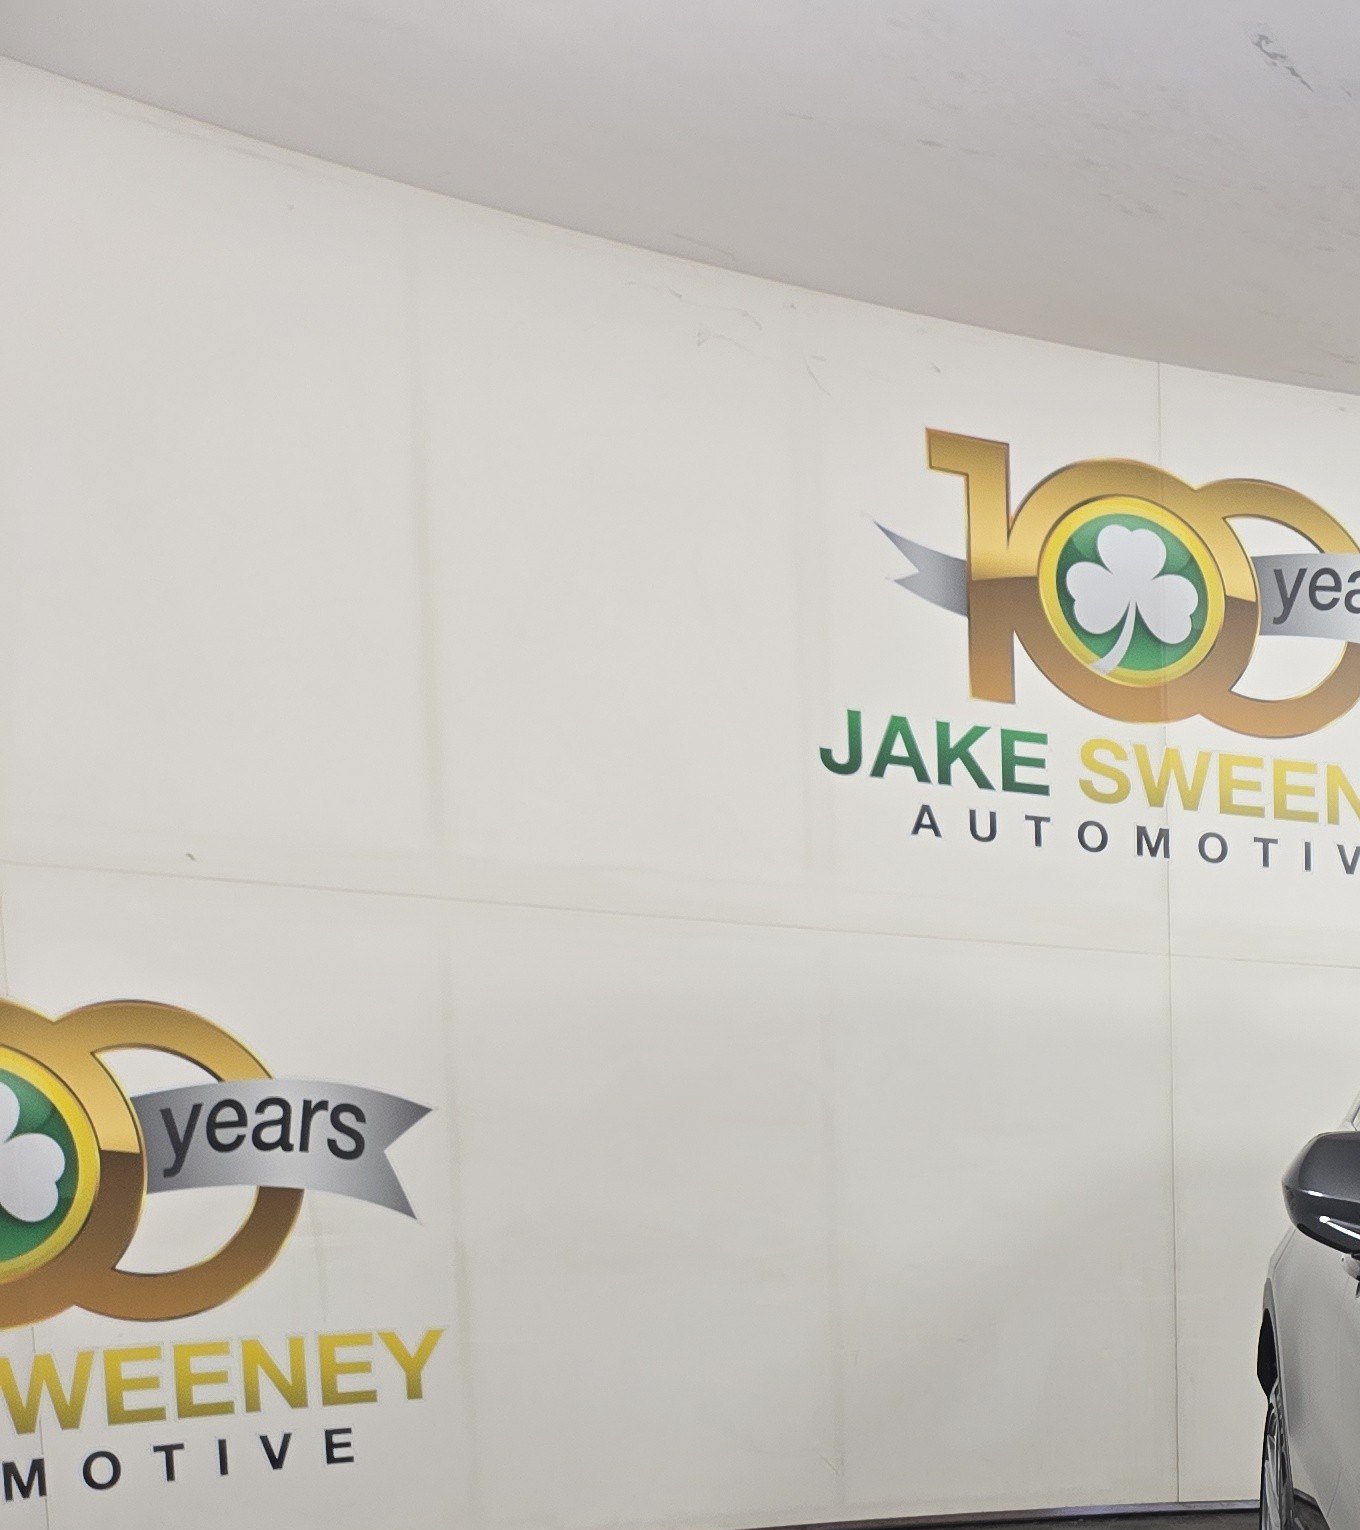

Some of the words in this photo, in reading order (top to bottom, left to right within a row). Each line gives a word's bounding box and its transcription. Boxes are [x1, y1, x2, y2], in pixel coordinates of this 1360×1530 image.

[819, 708, 1051, 796] JAKE
[159, 1095, 368, 1179] years
[1, 1427, 355, 1502] MOTIVE
